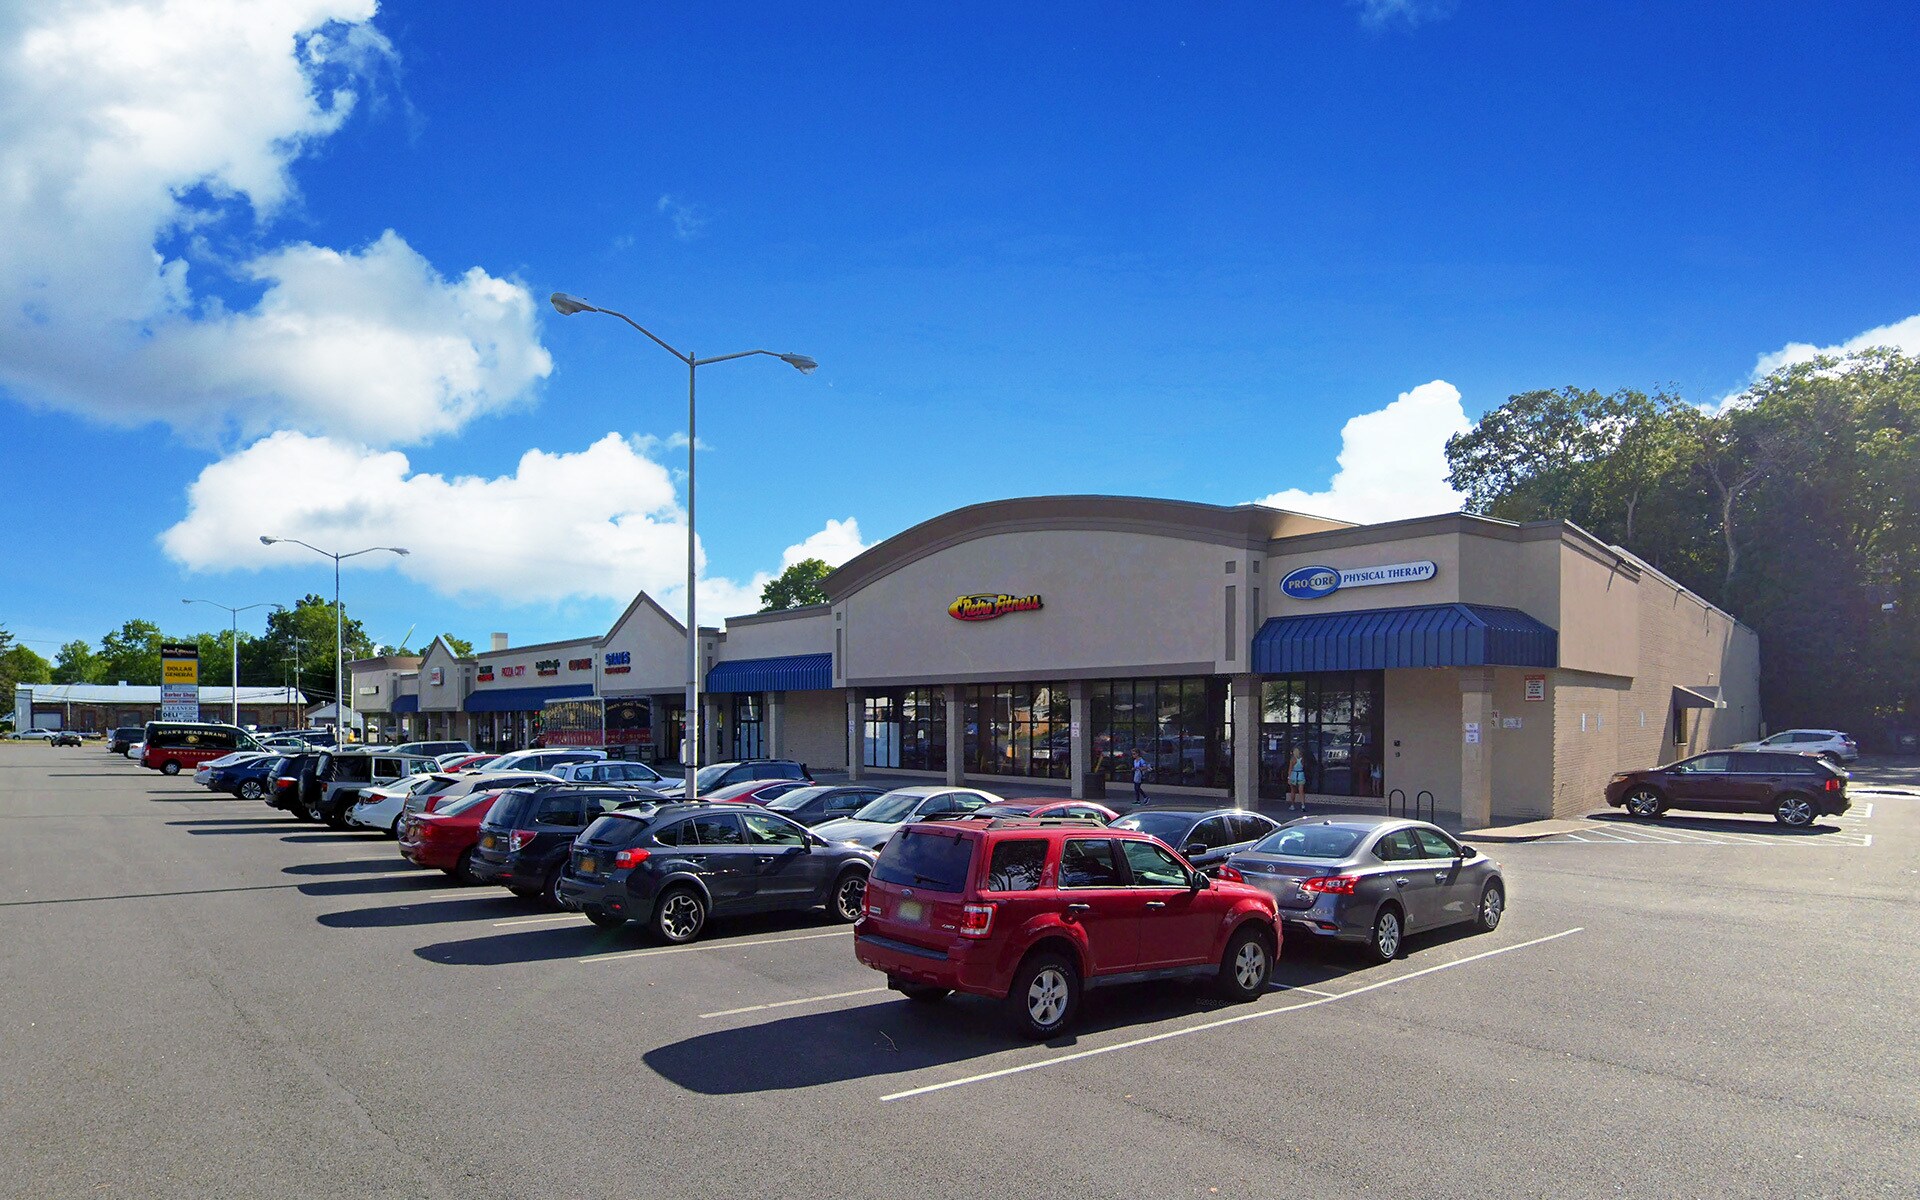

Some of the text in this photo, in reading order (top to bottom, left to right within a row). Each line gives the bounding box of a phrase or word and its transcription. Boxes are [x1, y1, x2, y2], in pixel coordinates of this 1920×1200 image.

[1288, 565, 1431, 589] PROCORE PHYSICAL THERAPY
[995, 594, 1041, 613] Fitness
